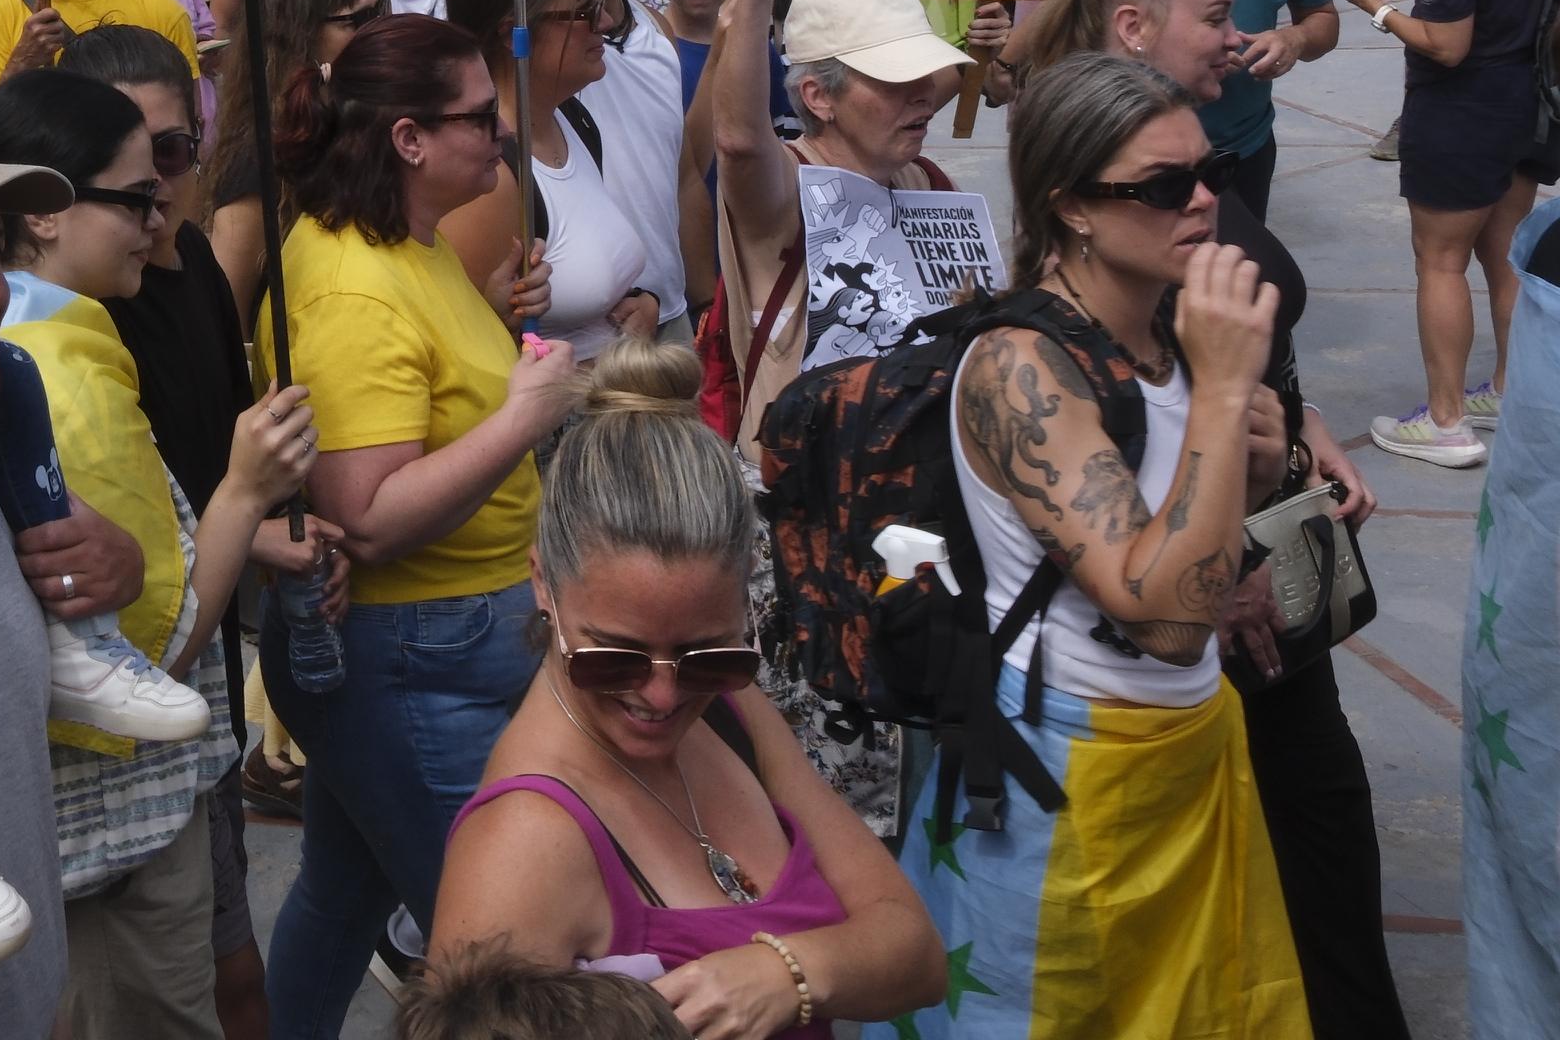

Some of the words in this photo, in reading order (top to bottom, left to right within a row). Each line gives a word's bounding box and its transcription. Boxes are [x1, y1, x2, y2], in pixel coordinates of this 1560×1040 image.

[897, 205, 975, 221] MANIFESTACIÓN
[900, 220, 981, 240] CANARIAS
[905, 239, 961, 262] TIENE
[959, 241, 990, 263] UN
